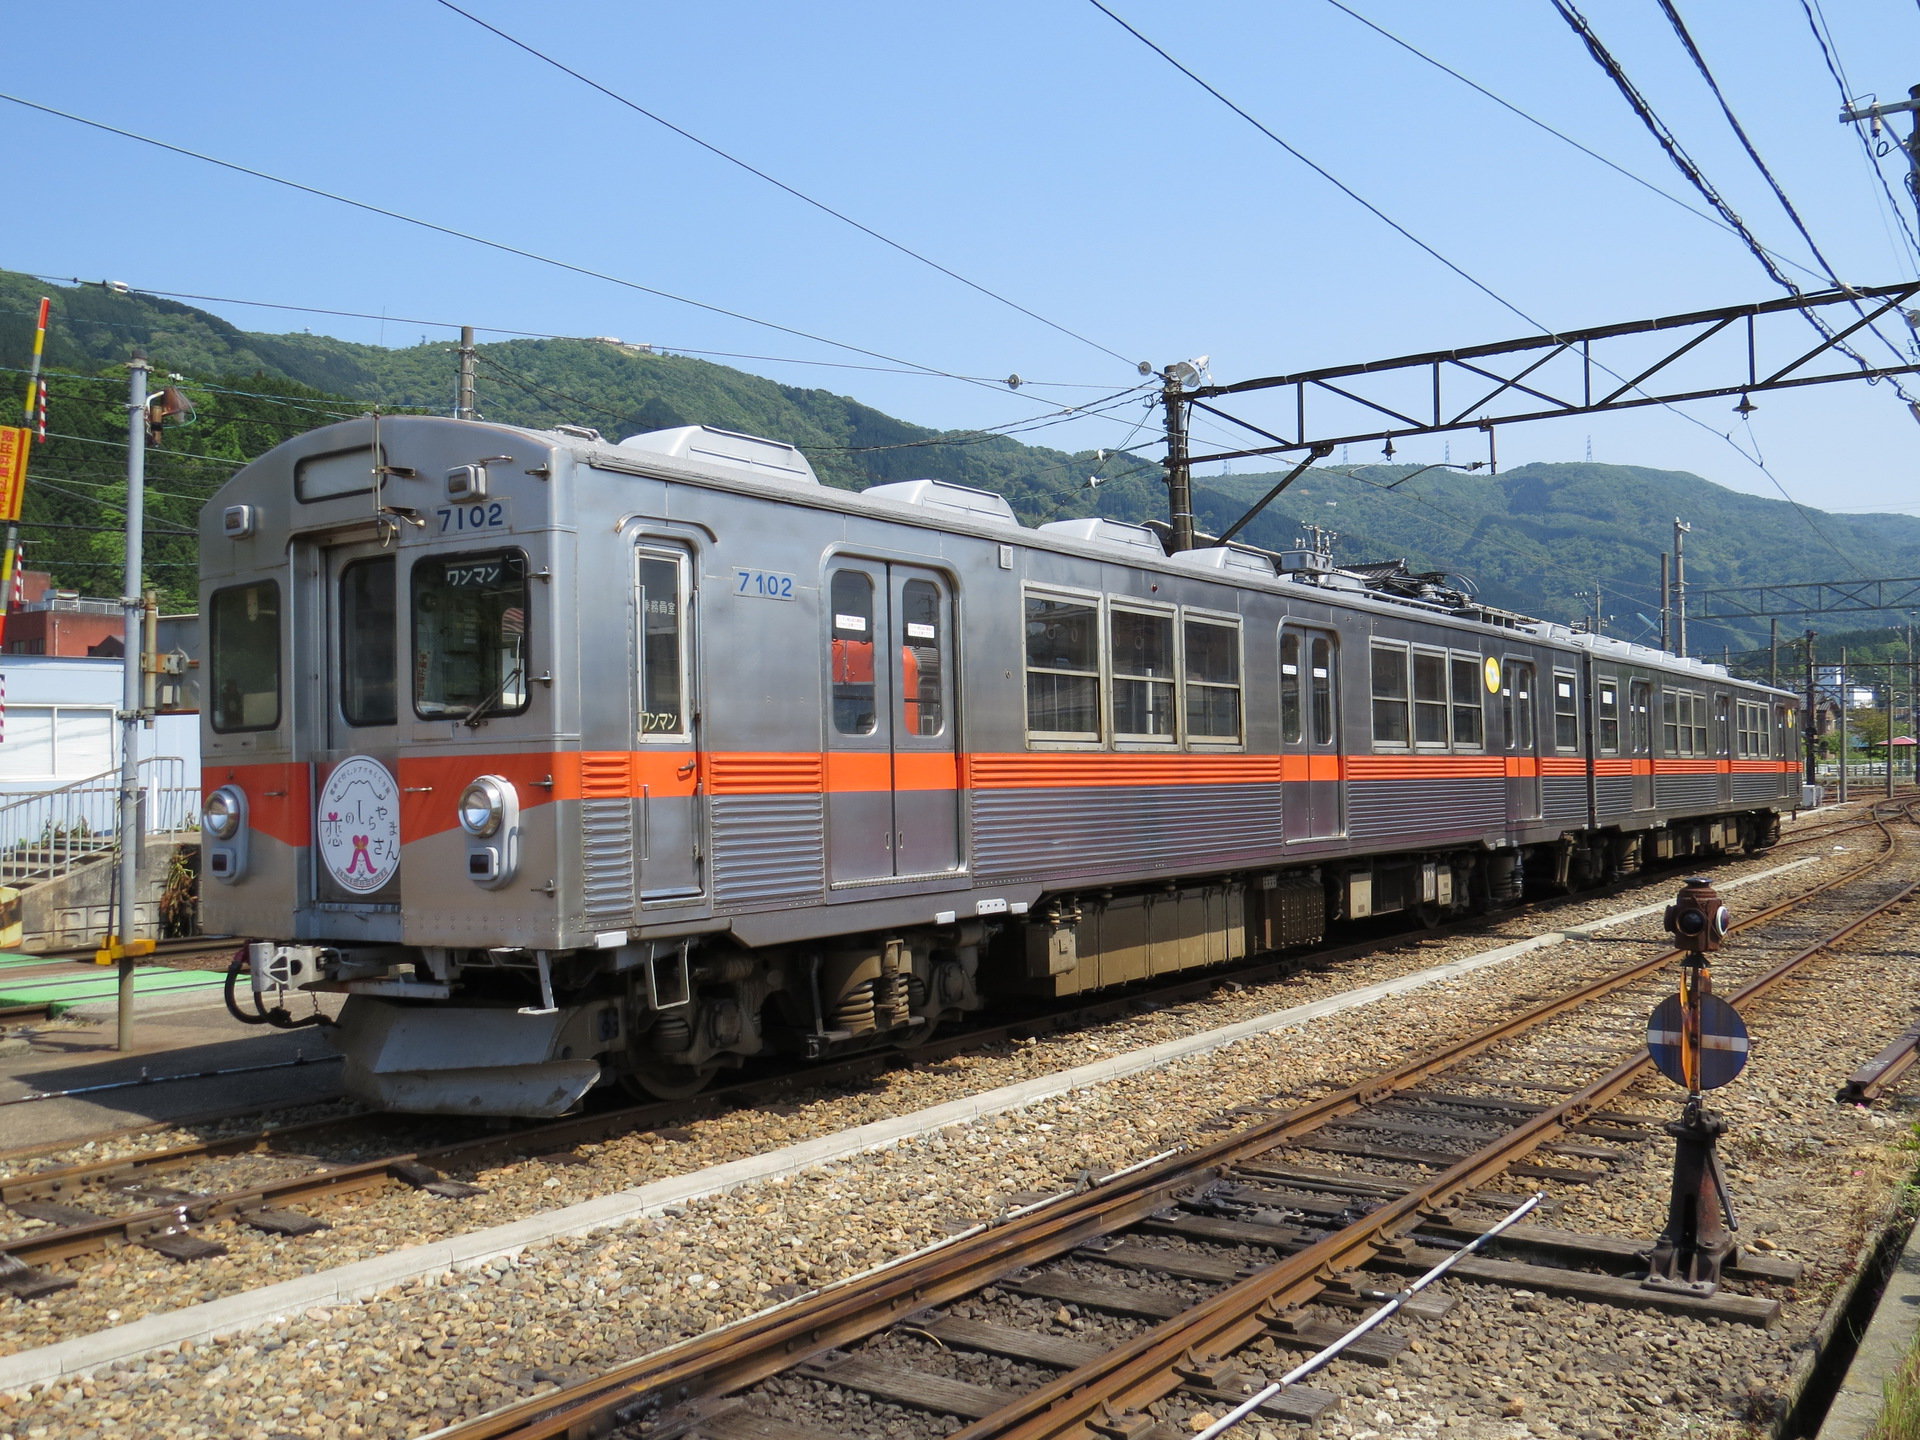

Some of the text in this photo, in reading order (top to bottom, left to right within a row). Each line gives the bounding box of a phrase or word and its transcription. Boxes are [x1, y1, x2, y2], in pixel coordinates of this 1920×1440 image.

[436, 502, 503, 532] 7102
[446, 566, 500, 587] ワンマン
[737, 572, 793, 598] 7102
